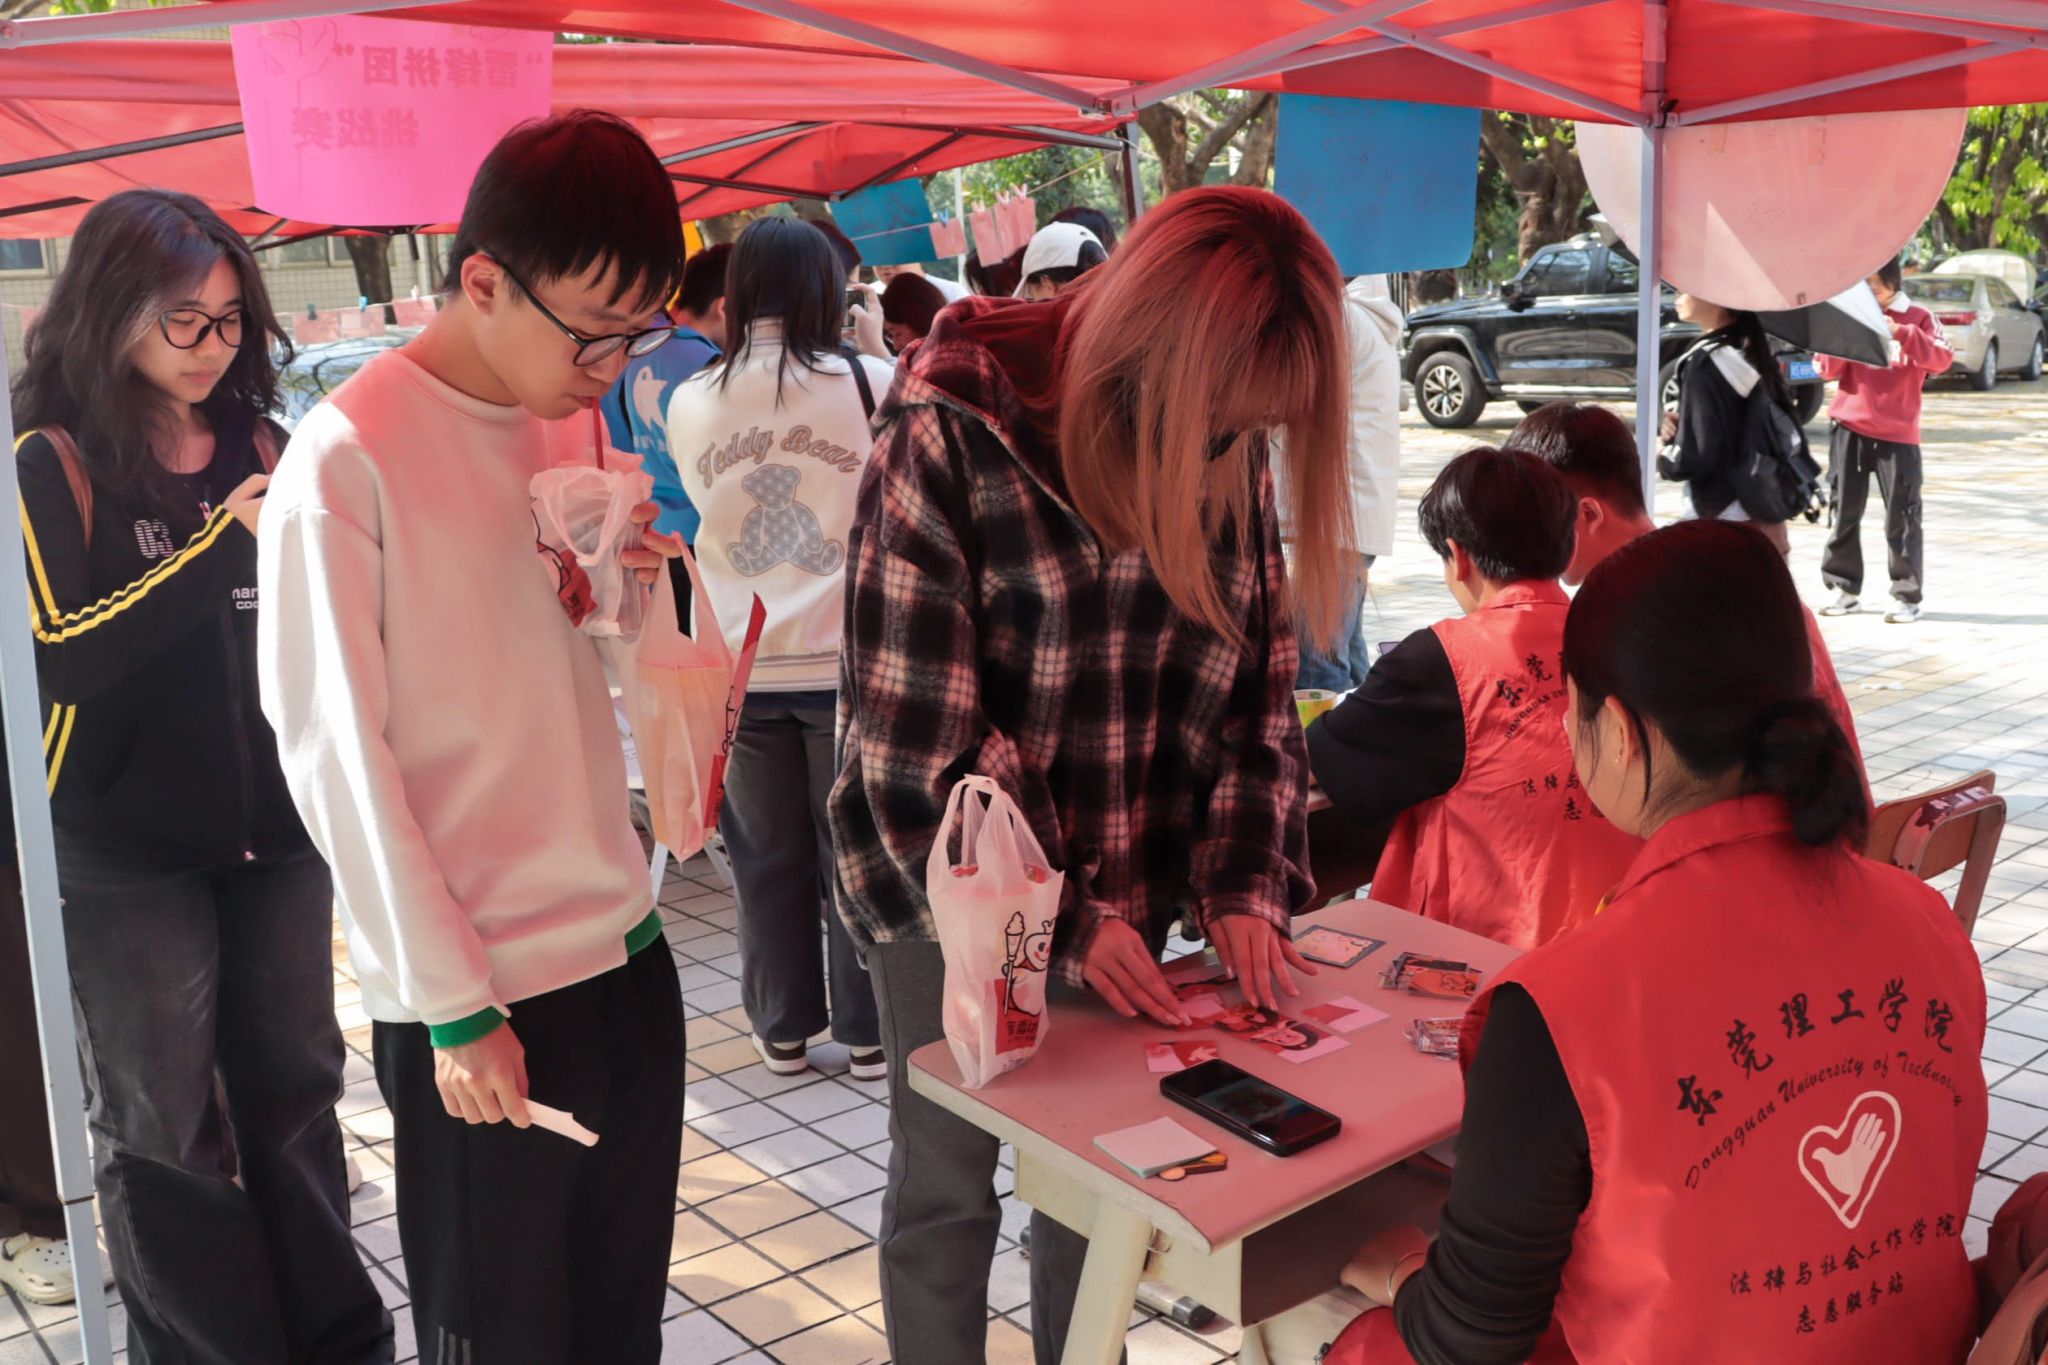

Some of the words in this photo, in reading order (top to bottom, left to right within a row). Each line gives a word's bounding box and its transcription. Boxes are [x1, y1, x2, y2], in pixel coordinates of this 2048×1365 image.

[696, 426, 774, 490] Teddy
[780, 424, 862, 474] Bear
[1496, 652, 1567, 707] 东莞
[1676, 977, 1954, 1127] 东莞理工学院
[1684, 1100, 1777, 1190] Dongguan
[1777, 1056, 1865, 1104] University
[1872, 1053, 1890, 1079] of
[1729, 1213, 1958, 1295] 法律与社会工作学院
[1795, 1270, 1905, 1335] 志愿服务站
